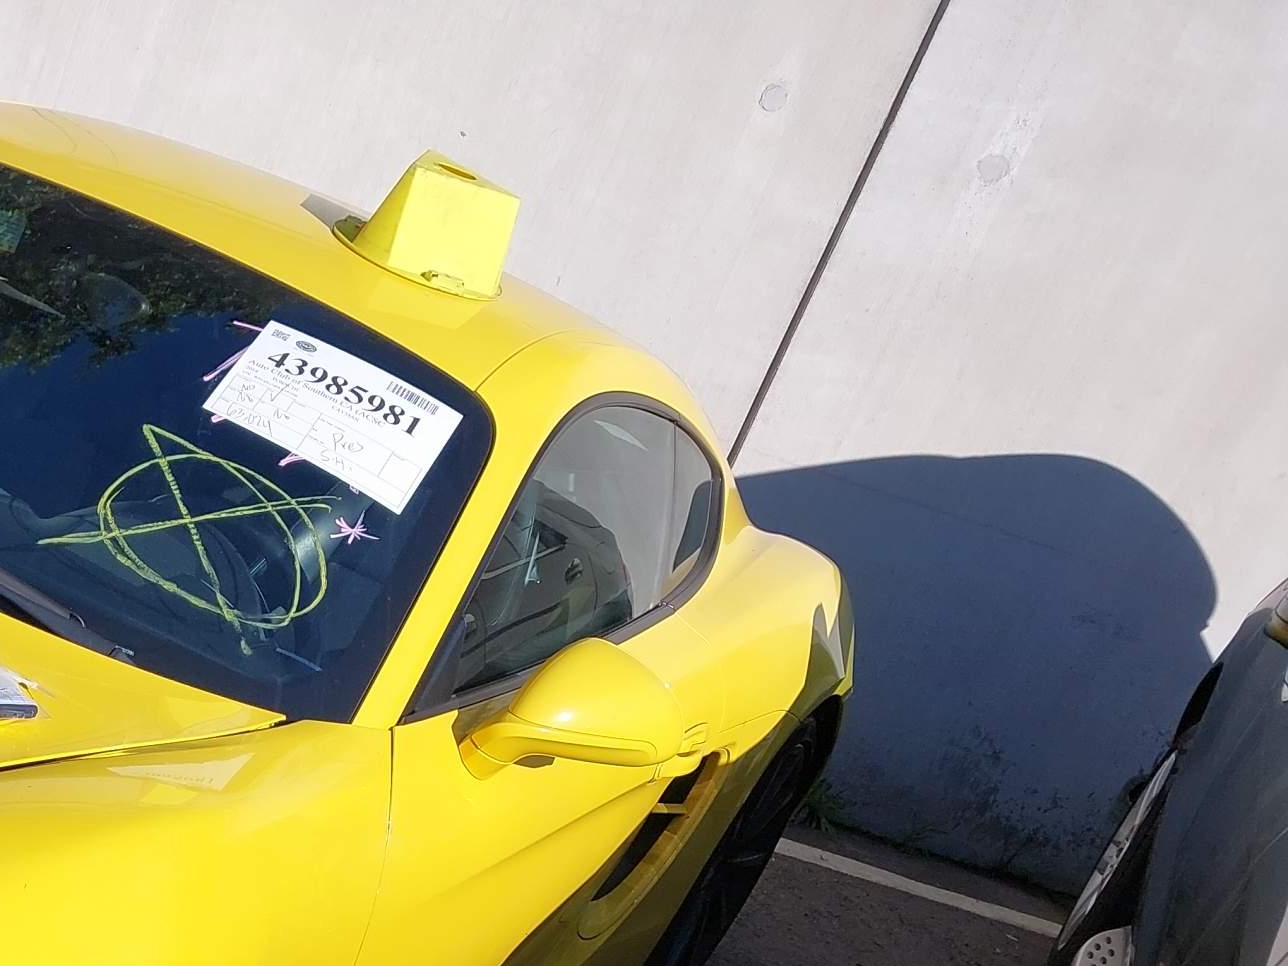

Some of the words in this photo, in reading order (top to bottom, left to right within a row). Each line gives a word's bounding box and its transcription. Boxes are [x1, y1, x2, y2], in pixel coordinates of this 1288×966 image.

[248, 359, 270, 372] Auto
[270, 366, 291, 381] Club
[291, 377, 302, 386] of
[302, 382, 338, 405] Southern
[268, 352, 421, 438] 43985981
